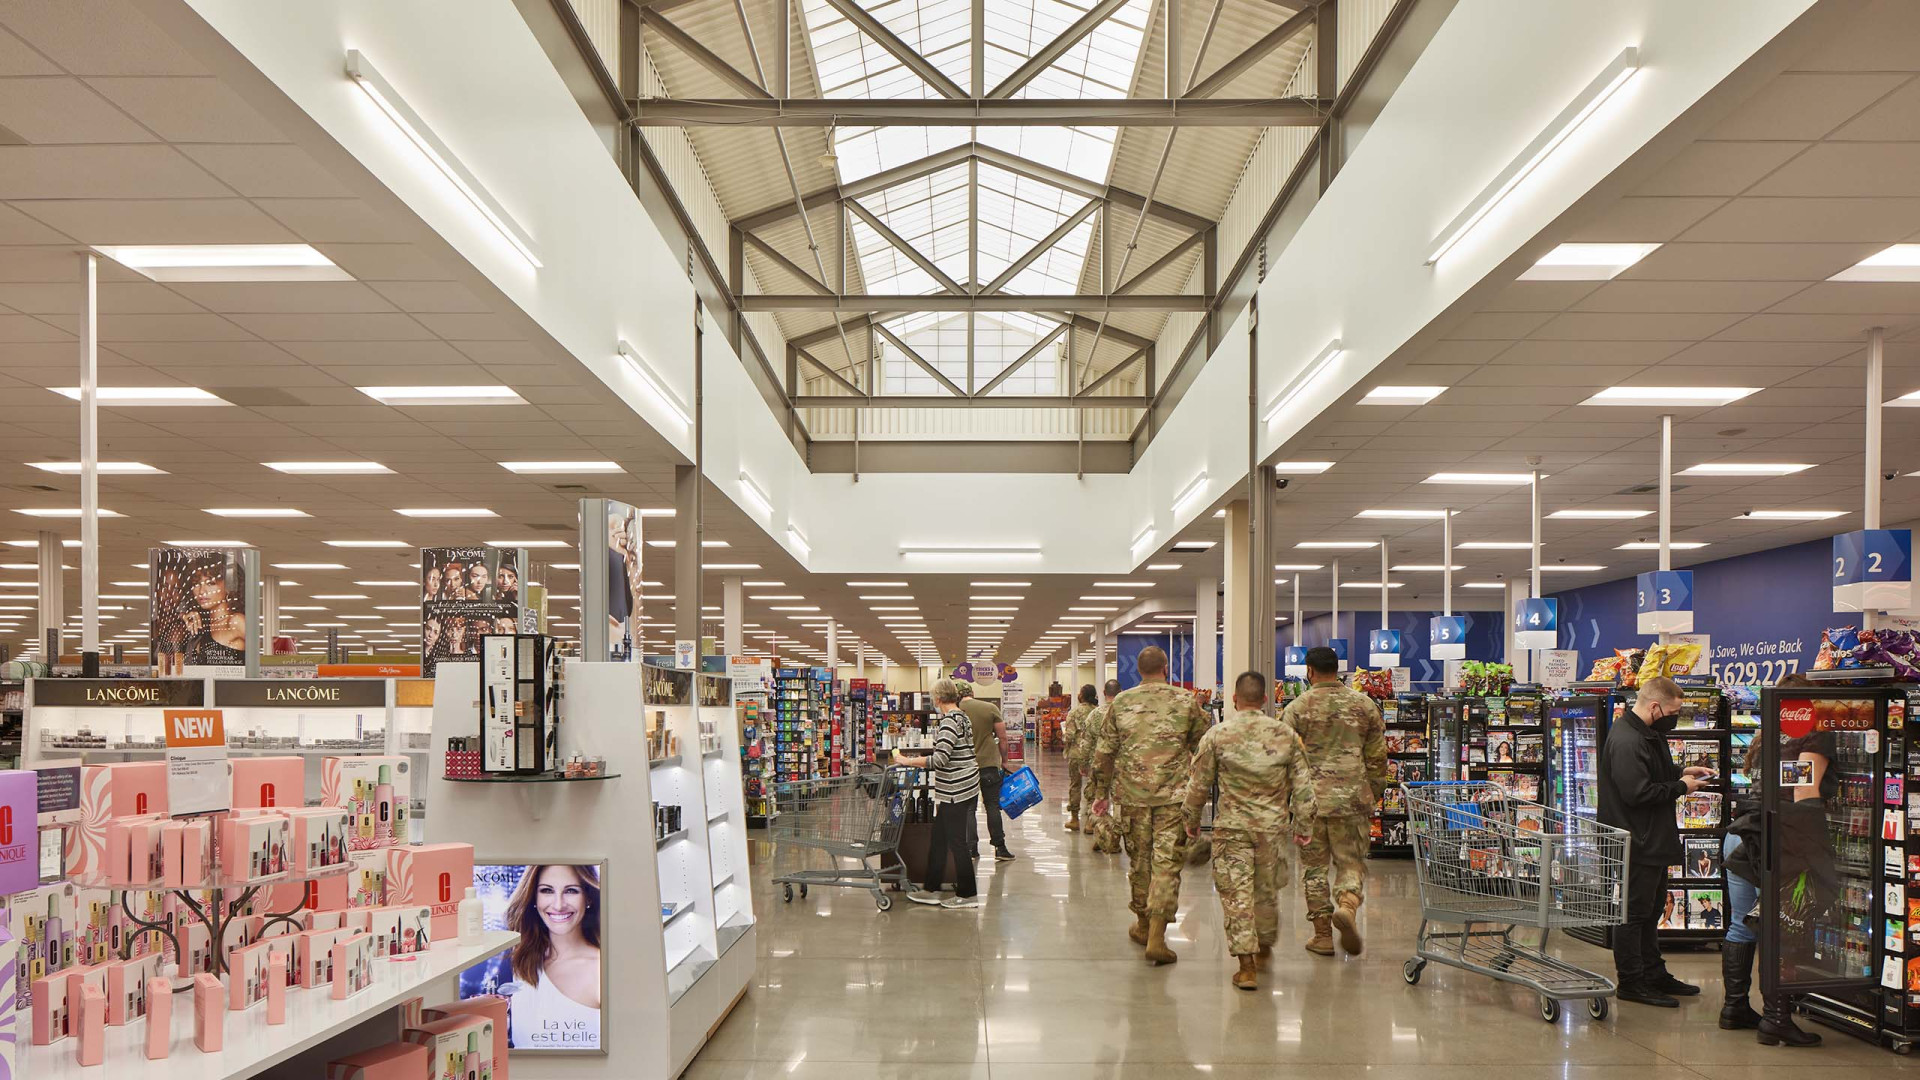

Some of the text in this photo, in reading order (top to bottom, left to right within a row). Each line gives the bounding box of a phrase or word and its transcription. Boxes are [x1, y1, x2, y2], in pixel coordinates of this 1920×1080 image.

[1836, 558, 1845, 578] 2
[1868, 552, 1882, 573] 2
[1639, 592, 1645, 607] 3
[1661, 588, 1671, 604] 3
[1516, 614, 1520, 627] 4
[1529, 613, 1540, 626] 4
[1442, 628, 1450, 640] 5
[1381, 640, 1388, 650] 6
[1716, 646, 1738, 659] Save,
[1740, 643, 1755, 656] We
[1756, 641, 1777, 655] Give
[1778, 638, 1803, 654] Back
[656, 659, 674, 667] fresh
[1291, 654, 1298, 662] 8
[86, 686, 160, 700] LANCÔME
[266, 686, 340, 700] LANCÔME
[174, 717, 214, 738] NEW
[0, 847, 26, 860] NIQUE
[432, 903, 458, 915] LINIQU
[543, 1019, 586, 1030] La vie
[531, 1032, 597, 1042] est belle
